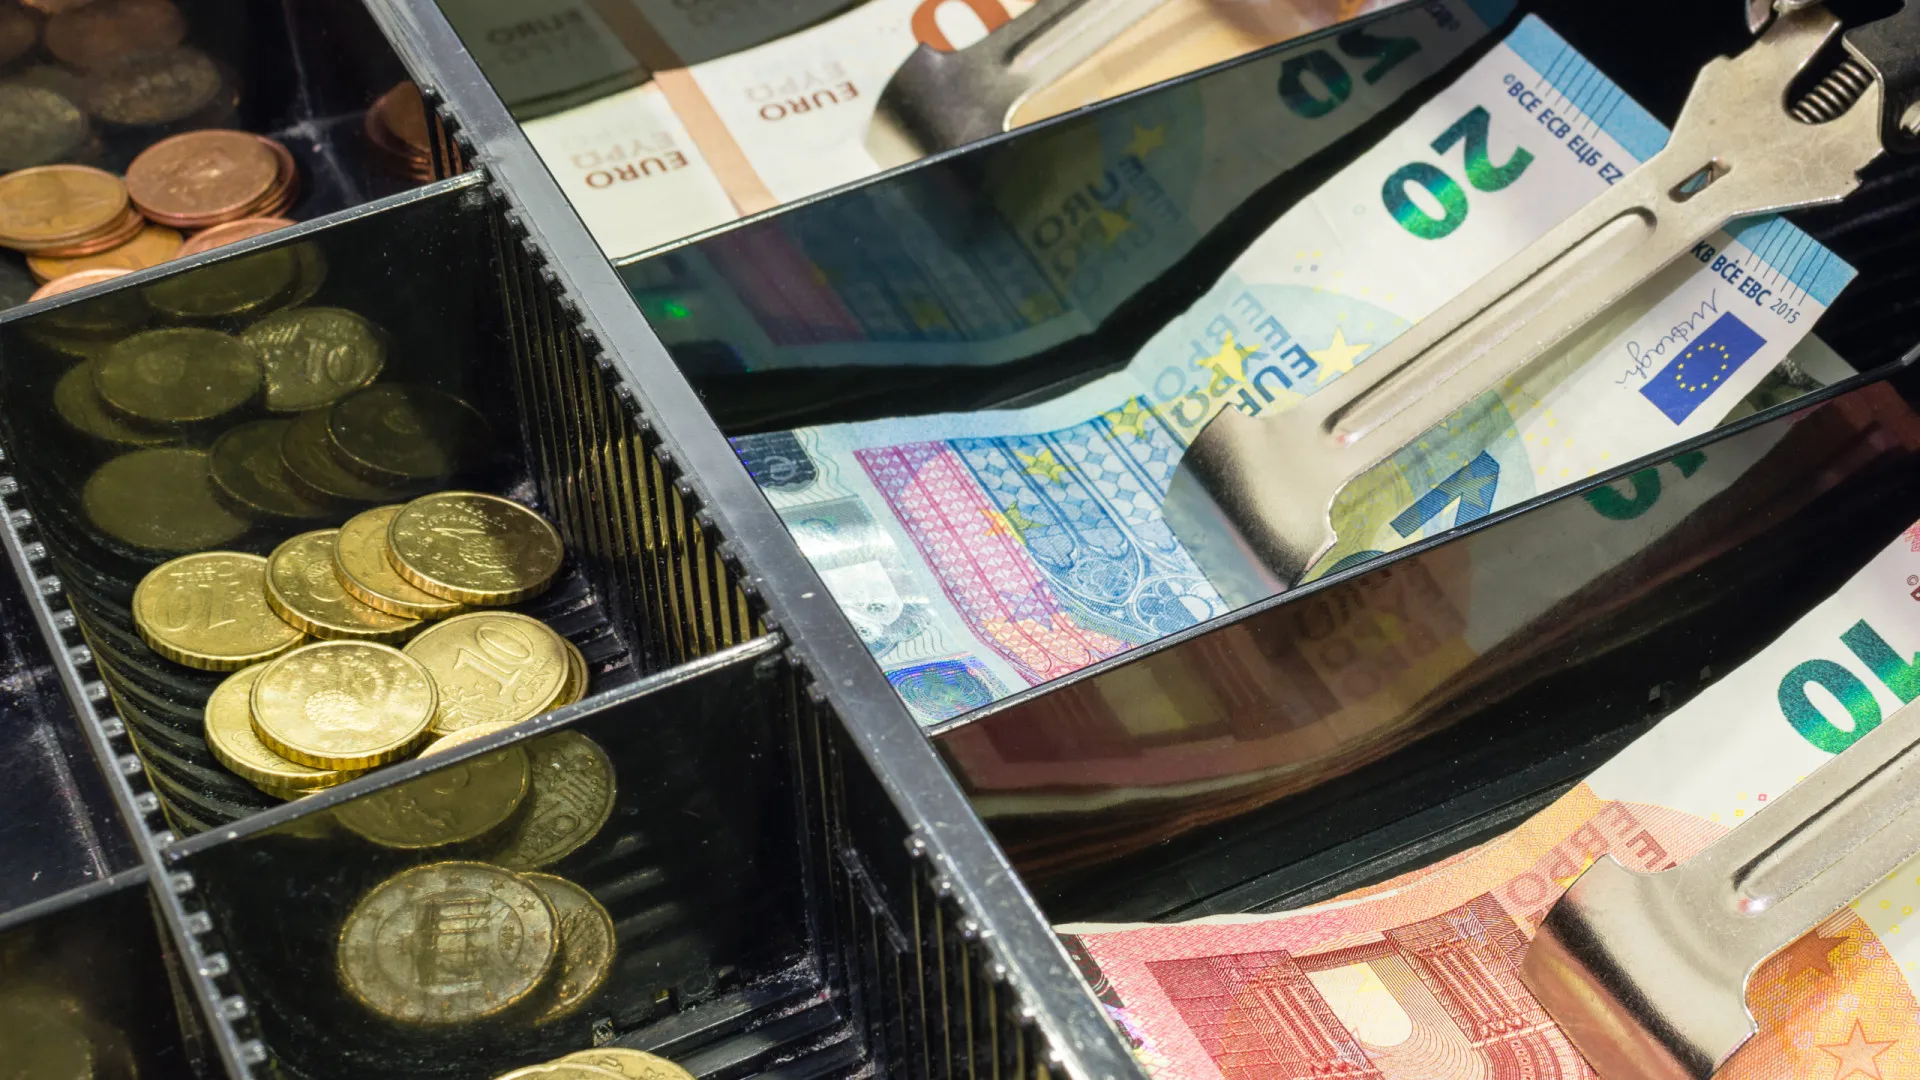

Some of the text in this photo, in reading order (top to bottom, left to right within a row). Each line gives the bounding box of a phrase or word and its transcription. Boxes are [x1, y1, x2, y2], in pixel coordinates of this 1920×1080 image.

[759, 80, 859, 121] EURO
[585, 150, 688, 189] EURO
[1382, 105, 1535, 240] 20
[1597, 162, 1624, 186] EZ
[1737, 276, 1772, 307] EBC
[1769, 298, 1800, 324] 2015
[453, 620, 534, 695] 10
[1777, 618, 1920, 755] 10
